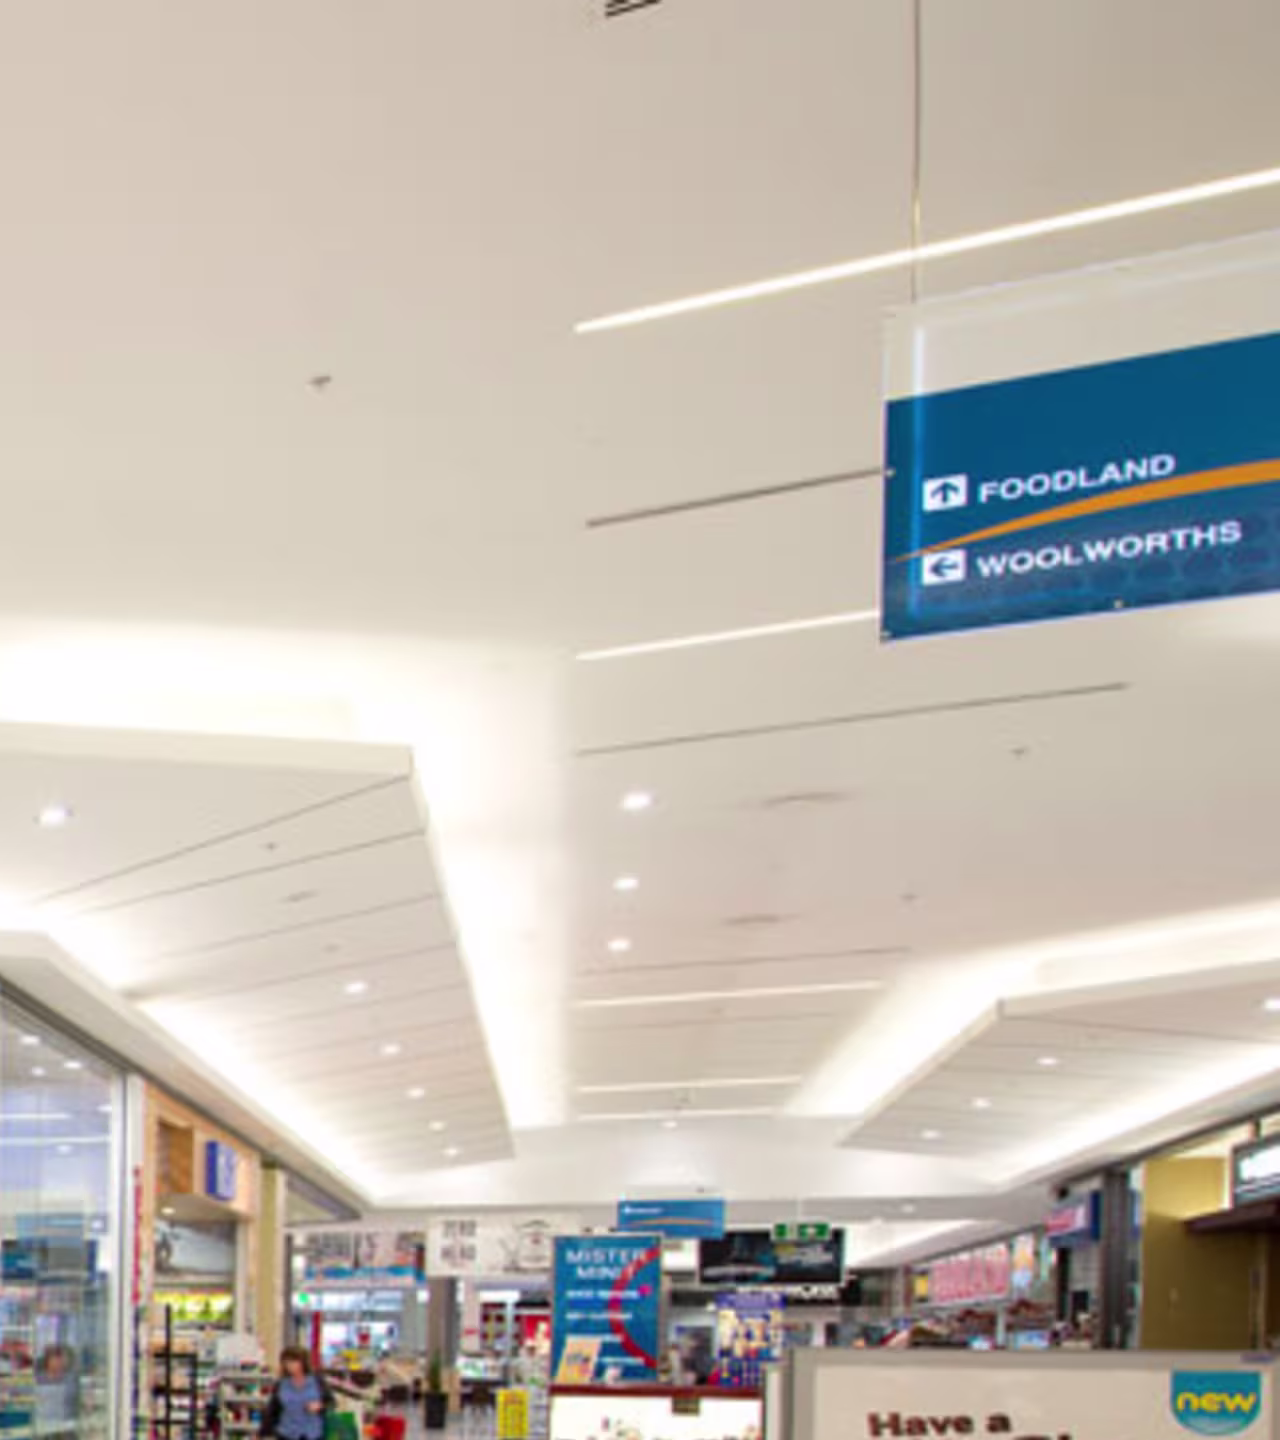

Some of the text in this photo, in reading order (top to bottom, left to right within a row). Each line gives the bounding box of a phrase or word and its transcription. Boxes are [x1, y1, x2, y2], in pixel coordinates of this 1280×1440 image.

[979, 455, 1176, 504] FOODLAND
[977, 521, 1242, 577] WOOLWORTHS
[1175, 1391, 1257, 1415] new
[867, 1411, 1011, 1438] Have a
